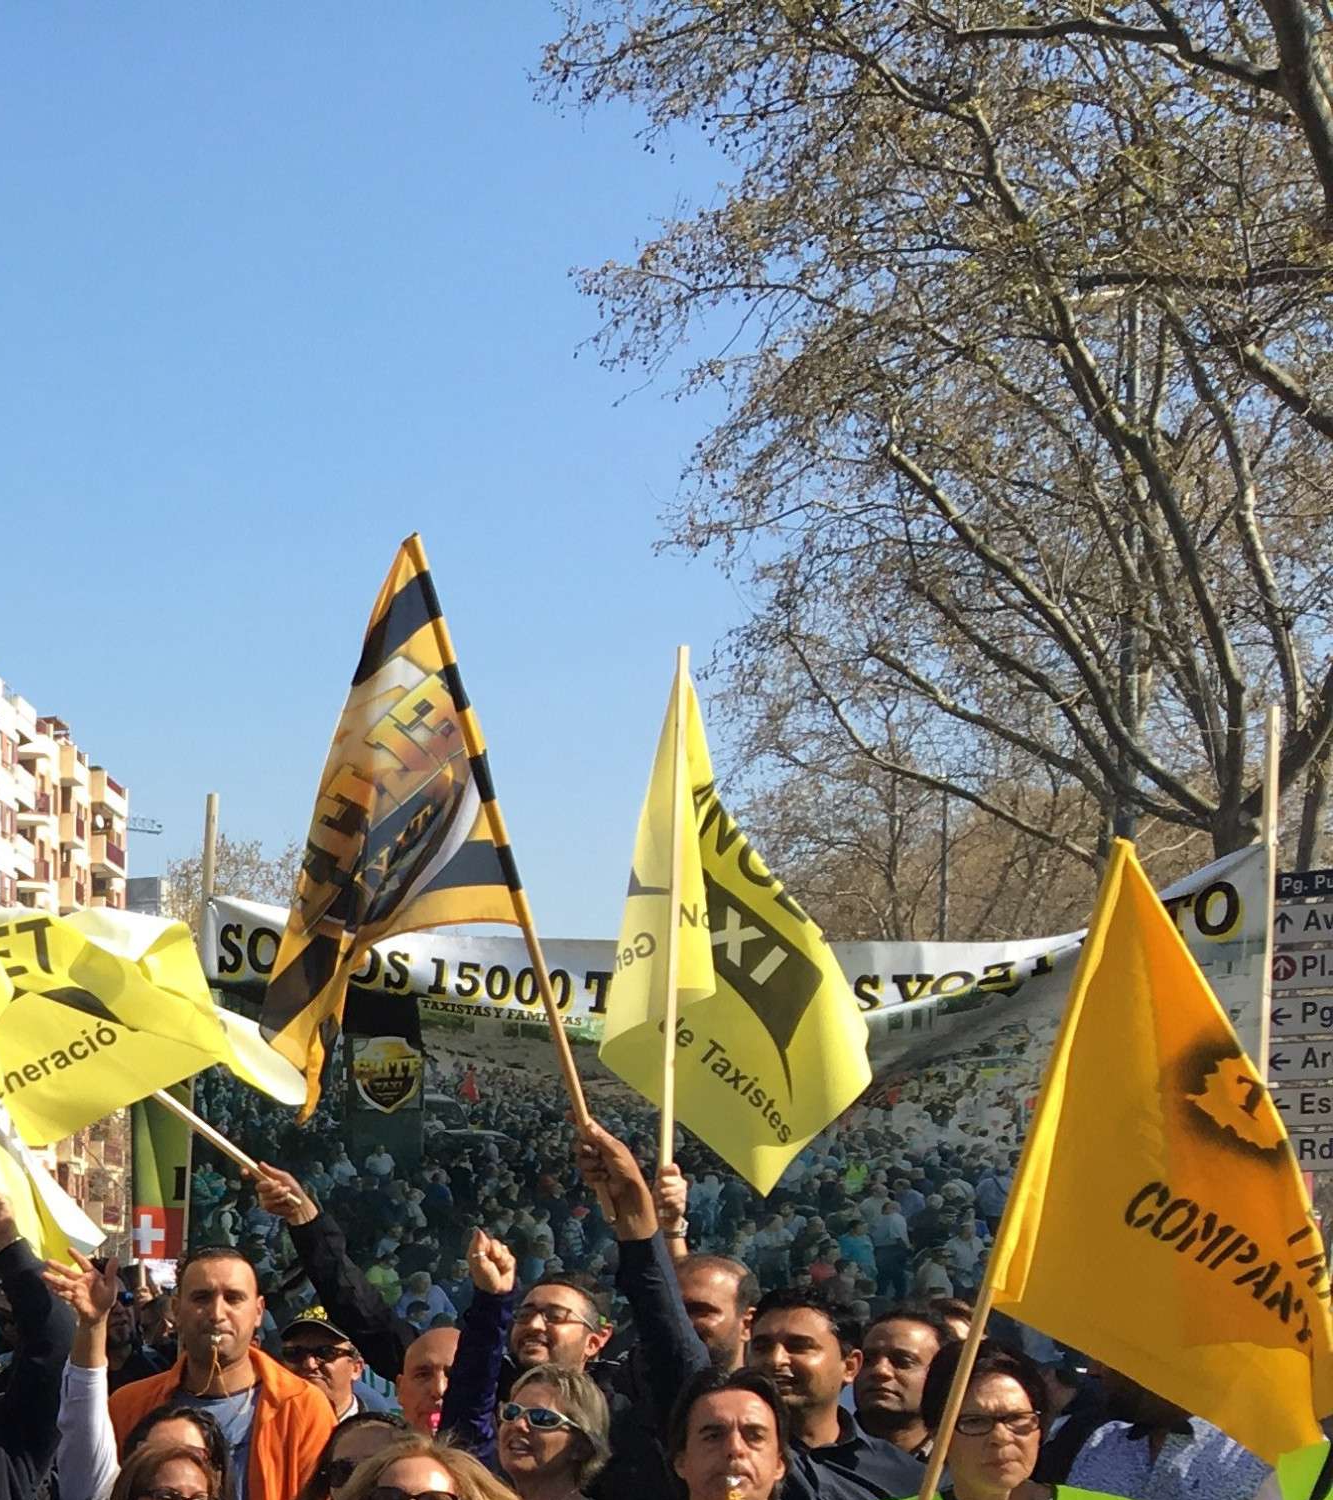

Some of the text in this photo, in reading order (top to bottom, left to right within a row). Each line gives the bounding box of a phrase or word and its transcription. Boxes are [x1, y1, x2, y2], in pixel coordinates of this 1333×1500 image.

[1281, 875, 1308, 894] Pg.
[421, 999, 492, 1018] TAXISTAS
[494, 1007, 504, 1019] Y
[427, 958, 571, 1010] 15000
[0, 1022, 118, 1098] neració
[699, 1038, 793, 1144] Taxistes
